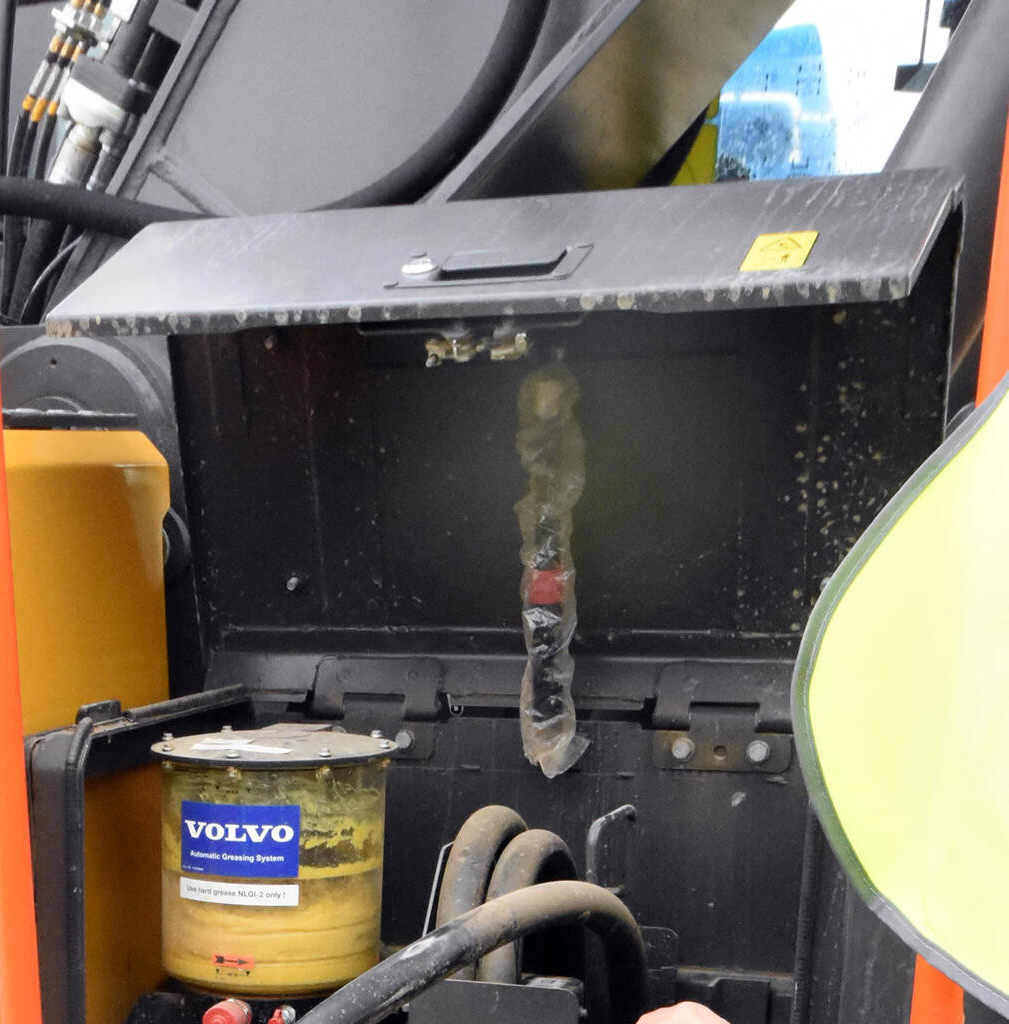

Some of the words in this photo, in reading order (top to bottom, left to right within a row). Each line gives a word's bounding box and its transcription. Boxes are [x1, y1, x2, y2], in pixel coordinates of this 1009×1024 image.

[184, 819, 295, 843] VOLVO
[190, 850, 221, 860] Automatic
[222, 853, 254, 863] Greasing
[256, 854, 284, 863] System
[186, 884, 197, 892] Use
[198, 886, 212, 895] hard
[213, 888, 236, 897] grease
[265, 891, 281, 899] only
